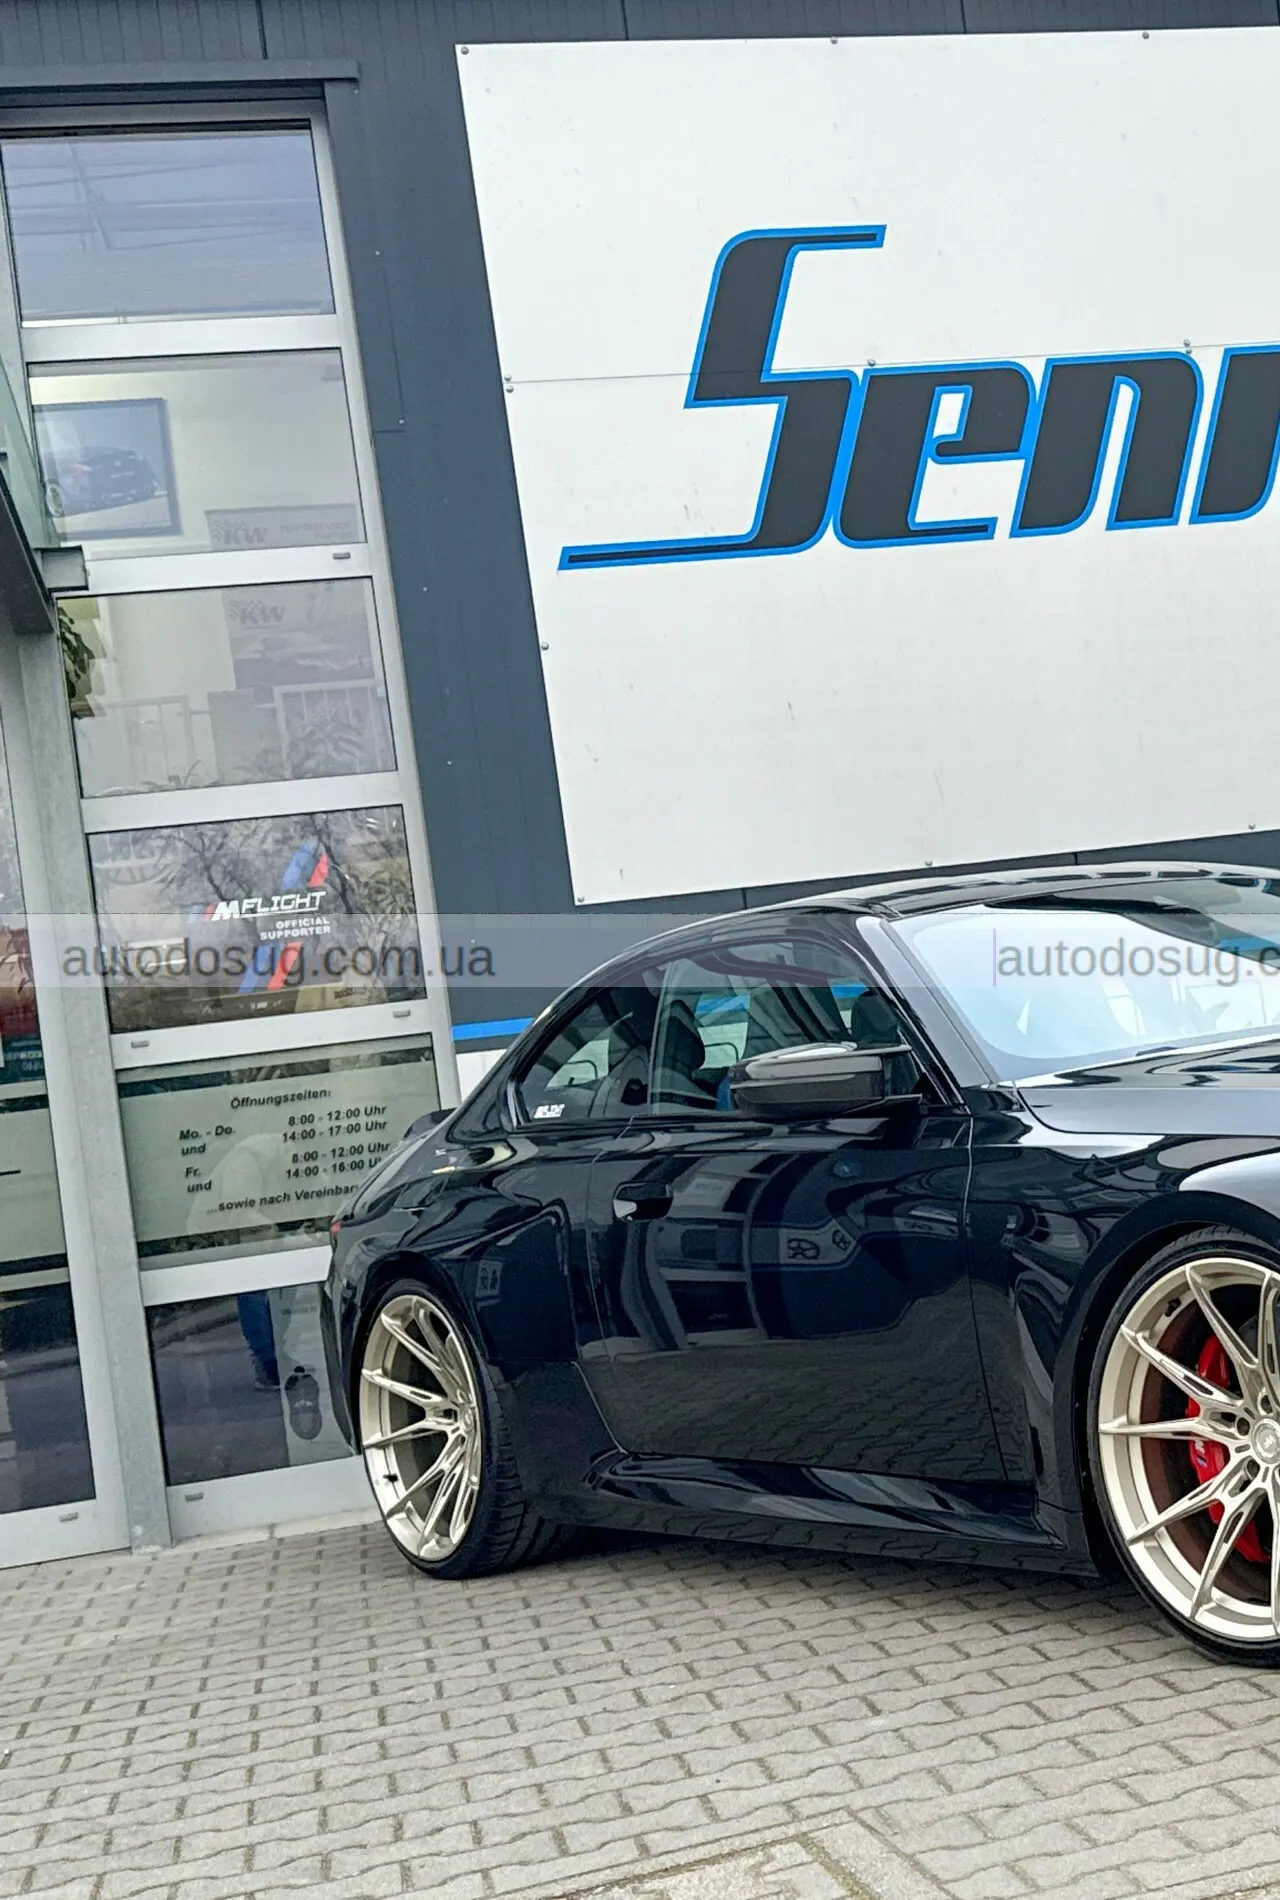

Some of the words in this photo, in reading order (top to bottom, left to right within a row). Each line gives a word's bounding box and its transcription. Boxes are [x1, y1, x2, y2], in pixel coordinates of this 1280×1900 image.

[260, 925, 331, 941] SUPPORTER
[275, 916, 330, 929] OFFICIAL
[230, 1089, 331, 1109] Öffnungszeiten:
[179, 1129, 202, 1140] Mo.
[215, 1125, 235, 1136] Do.
[288, 1113, 315, 1127] 8:00
[327, 1108, 360, 1121] 12:00
[364, 1105, 387, 1117] Uhr
[181, 1142, 206, 1156] und
[282, 1128, 316, 1142] 14:00
[328, 1122, 361, 1136] 17:00
[365, 1120, 387, 1132] Uhr
[185, 1166, 201, 1178] Fr.
[330, 1144, 364, 1158] 12:00
[368, 1141, 390, 1153] Uhr
[187, 1180, 212, 1193] und
[285, 1165, 319, 1179] 14:00
[260, 1192, 291, 1206] nach
[295, 1184, 359, 1200] Vereinbar
